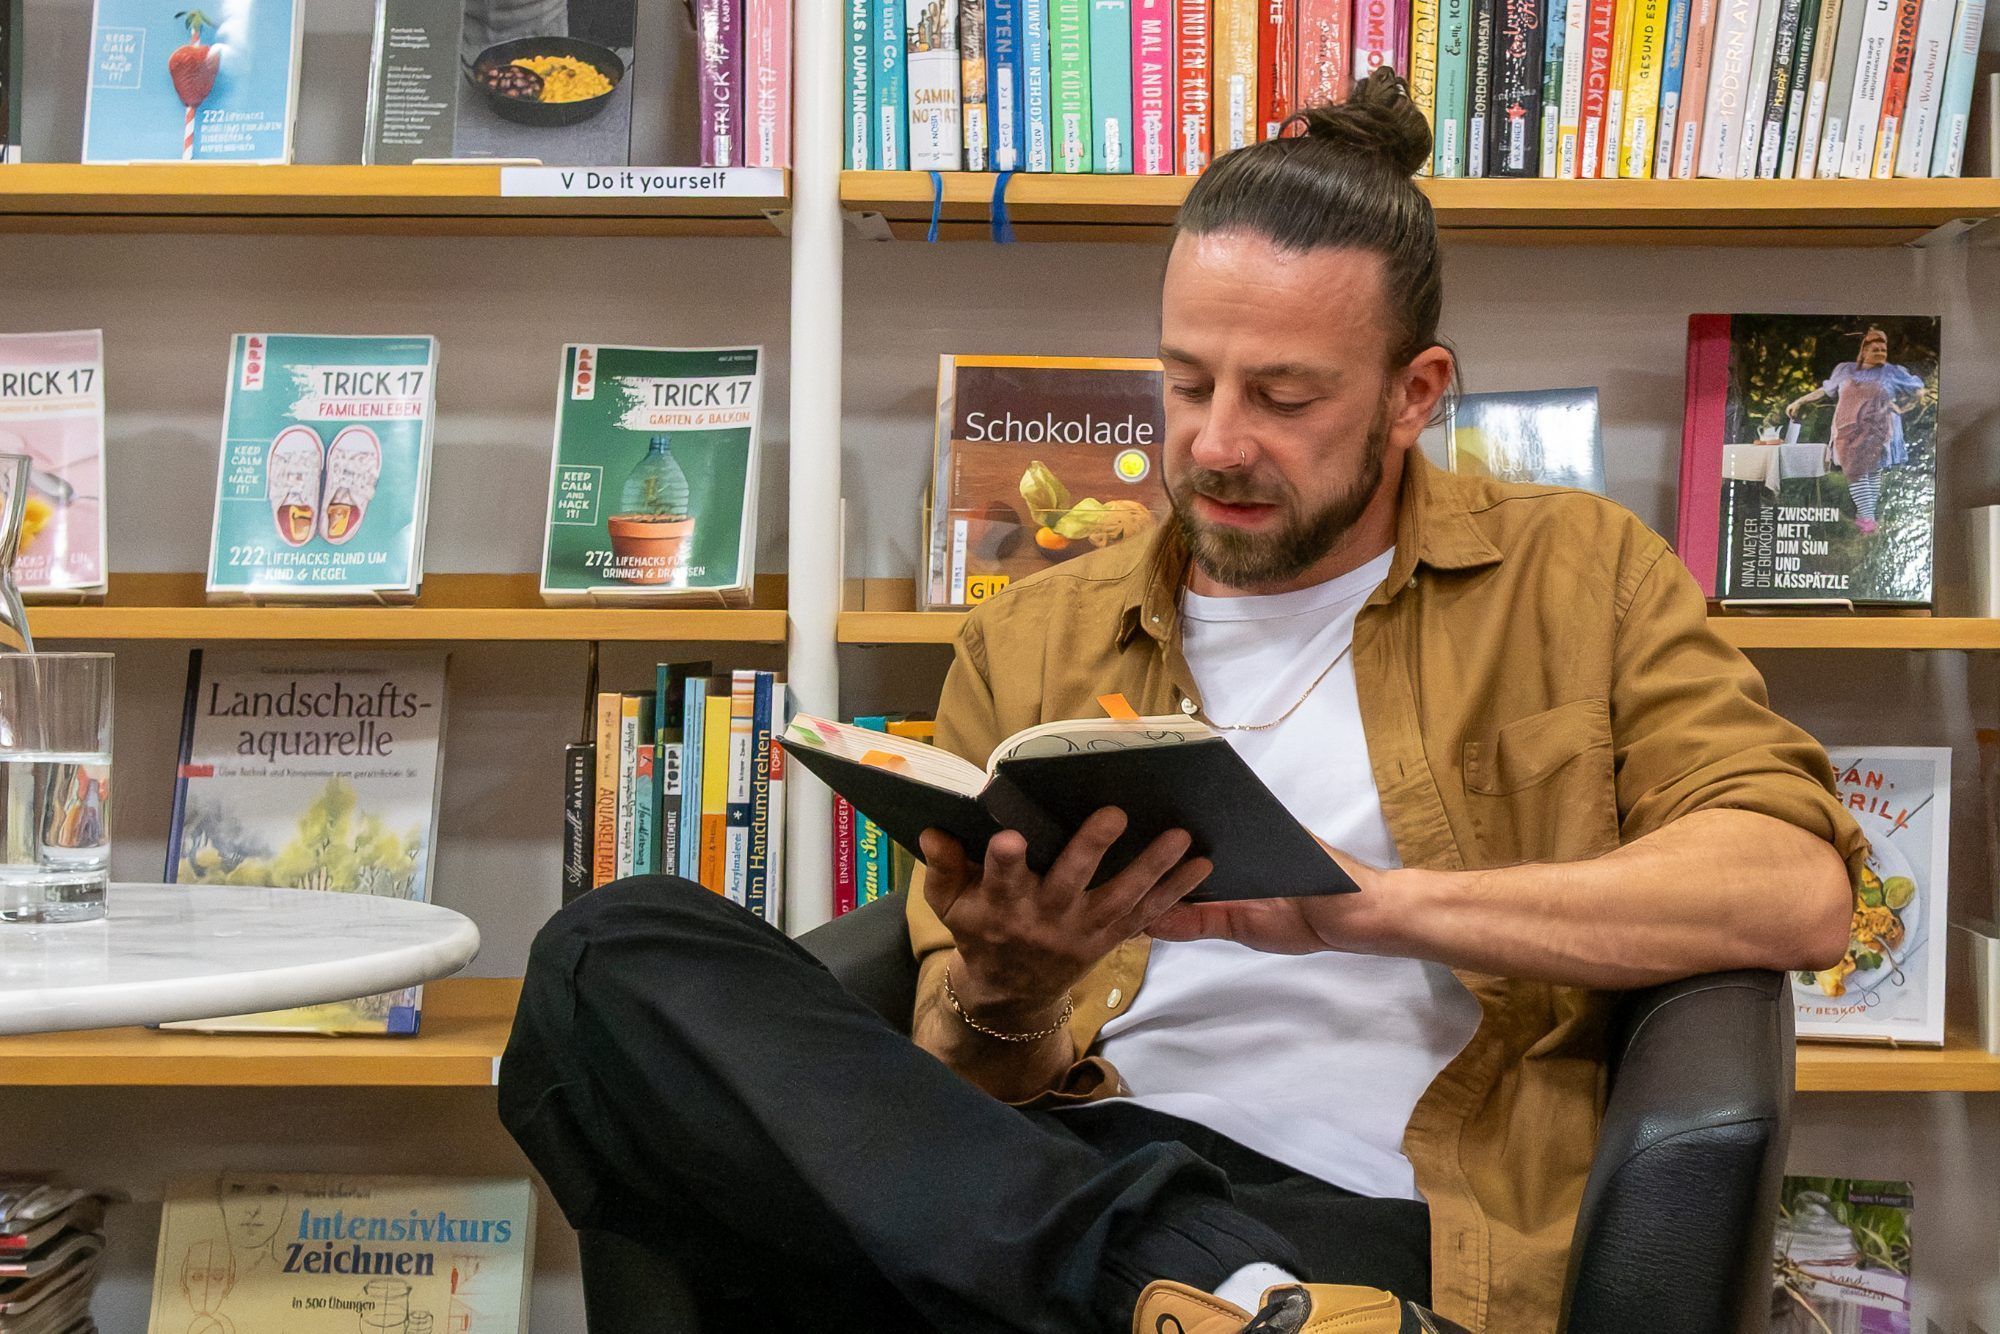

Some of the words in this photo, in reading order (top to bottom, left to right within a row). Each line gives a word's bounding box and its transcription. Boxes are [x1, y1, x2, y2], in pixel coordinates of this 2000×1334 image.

[883, 8, 897, 40] und
[1029, 0, 1042, 39] JAMI
[1141, 19, 1161, 55] MAL
[1367, 0, 1385, 70] OMFO
[1477, 12, 1490, 64] RAMSAY
[1639, 25, 1654, 79] GESUND
[853, 46, 866, 114] DUMPLIN
[714, 72, 730, 134] TRICK
[914, 88, 956, 106] SAMIN
[202, 109, 225, 124] 222
[561, 173, 575, 190] V
[586, 173, 613, 190] Do
[619, 171, 634, 190] it
[640, 171, 727, 194] yourself
[67, 368, 95, 394] 17
[322, 371, 392, 396] TRICK
[396, 371, 424, 396] 17
[576, 348, 593, 396] TOPP
[652, 382, 721, 407] TRICK
[725, 381, 752, 405] 17
[649, 413, 692, 425] GARTEN
[708, 411, 750, 423] BALKON
[965, 411, 1154, 445] Schokolade
[231, 455, 263, 466] CALM
[233, 445, 262, 455] KEEP
[228, 474, 260, 484] HACK
[561, 481, 592, 491] CALM
[563, 471, 591, 481] KEEP
[558, 500, 590, 509] HACK
[1777, 506, 1840, 523] ZWISCHEN
[1743, 518, 1758, 557] MEYER
[1776, 523, 1811, 540] METT,
[228, 546, 266, 567] 222
[266, 552, 330, 566] LIFEHACKS
[331, 552, 365, 566] RUND
[367, 552, 387, 564] UM
[585, 550, 613, 567] 272
[615, 556, 666, 567] LIFEHACKS
[1775, 540, 1799, 555] DIM
[1801, 540, 1829, 556] SUM
[311, 567, 348, 580] KEGEL
[602, 567, 644, 579] DRINNEN
[1741, 559, 1757, 588] NINA
[1775, 556, 1800, 572] UND
[1757, 569, 1771, 588] DIE
[1773, 571, 1850, 590] KÄSSPÄTZLE
[207, 681, 432, 719] Landschafts-
[236, 720, 394, 764] aquarelle
[666, 749, 680, 792] TOPP
[771, 747, 781, 774] TOPP
[748, 728, 770, 870] Handumdrehen
[838, 840, 849, 884] EINFACH
[748, 876, 764, 899] im
[1815, 1004, 1867, 1016] BESKOW
[298, 1208, 512, 1245] Intensivkurs
[282, 1242, 434, 1276] Zeichnen
[291, 1297, 303, 1309] in
[304, 1297, 327, 1310] 500
[328, 1296, 376, 1312] Übungen
